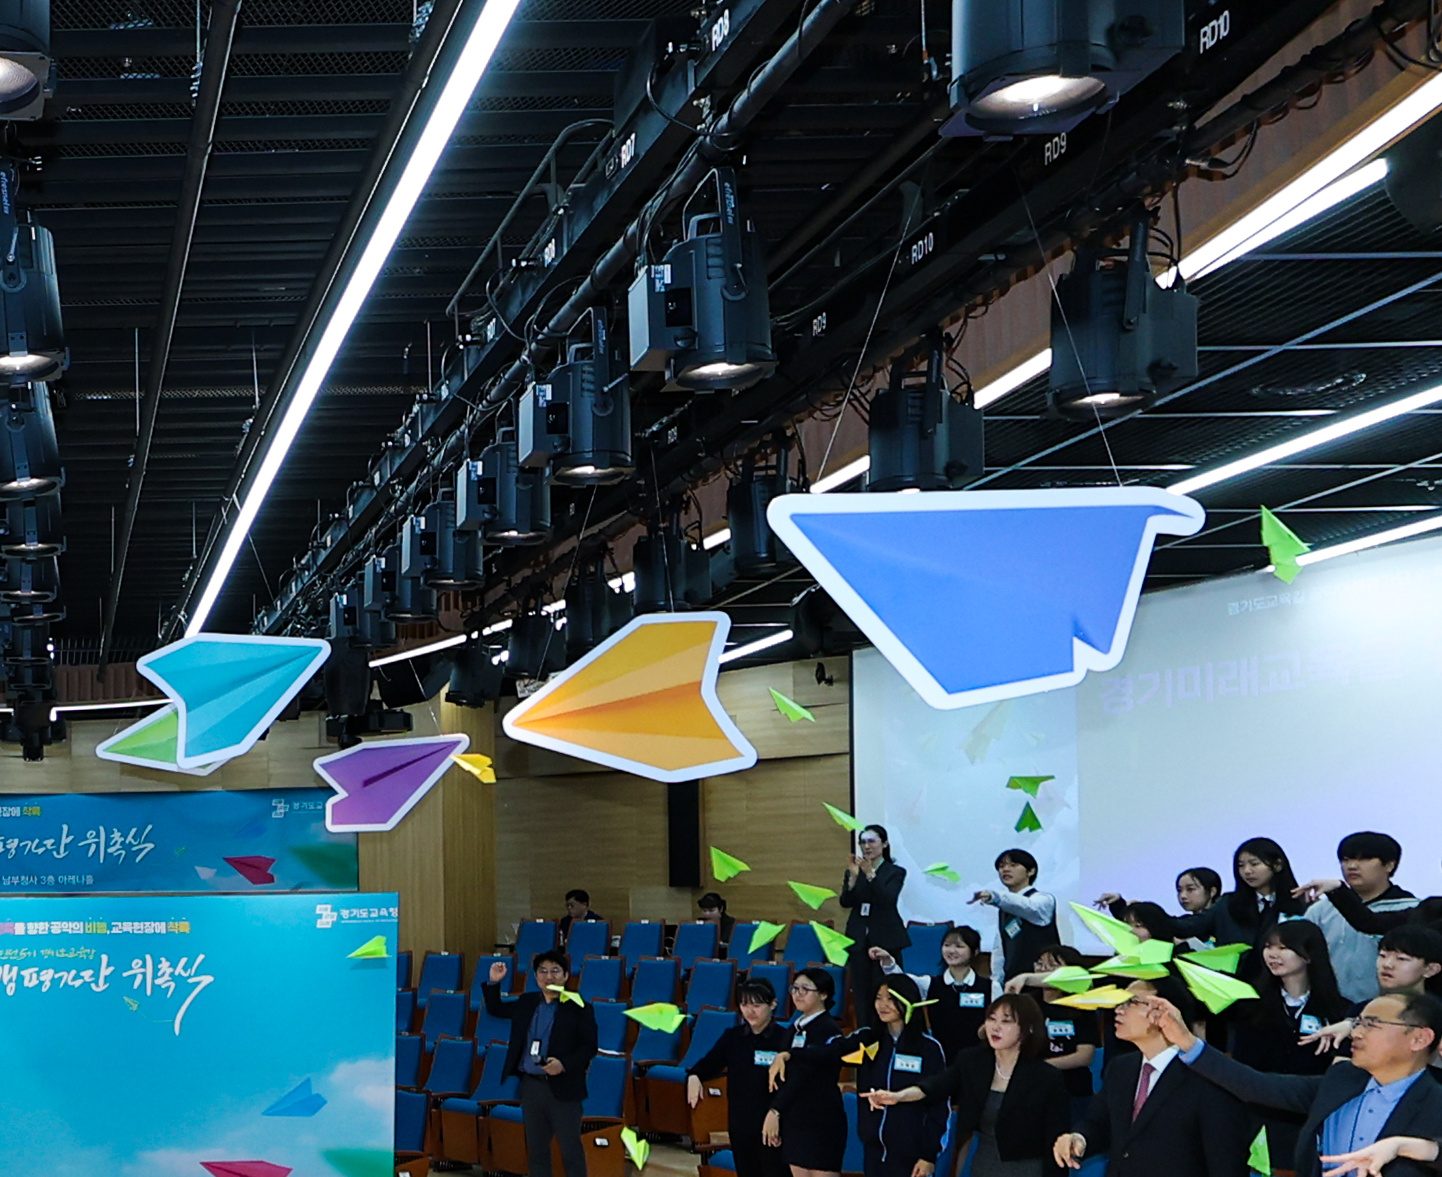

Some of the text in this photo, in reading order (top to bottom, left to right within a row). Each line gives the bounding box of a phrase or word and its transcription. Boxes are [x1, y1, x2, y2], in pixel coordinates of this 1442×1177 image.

[1199, 10, 1231, 54] RD10
[1044, 132, 1067, 166] RD9
[910, 238, 935, 265] RD10
[812, 311, 827, 336] RD9
[78, 824, 155, 864] 위촉식
[1, 875, 37, 887] 남부청사
[40, 876, 55, 886] 3층
[340, 907, 398, 919] 경기도교육청
[27, 922, 49, 935] 향한
[50, 922, 84, 935] 공약의
[111, 922, 166, 935] 교육현장에
[122, 953, 215, 1036] 위촉식
